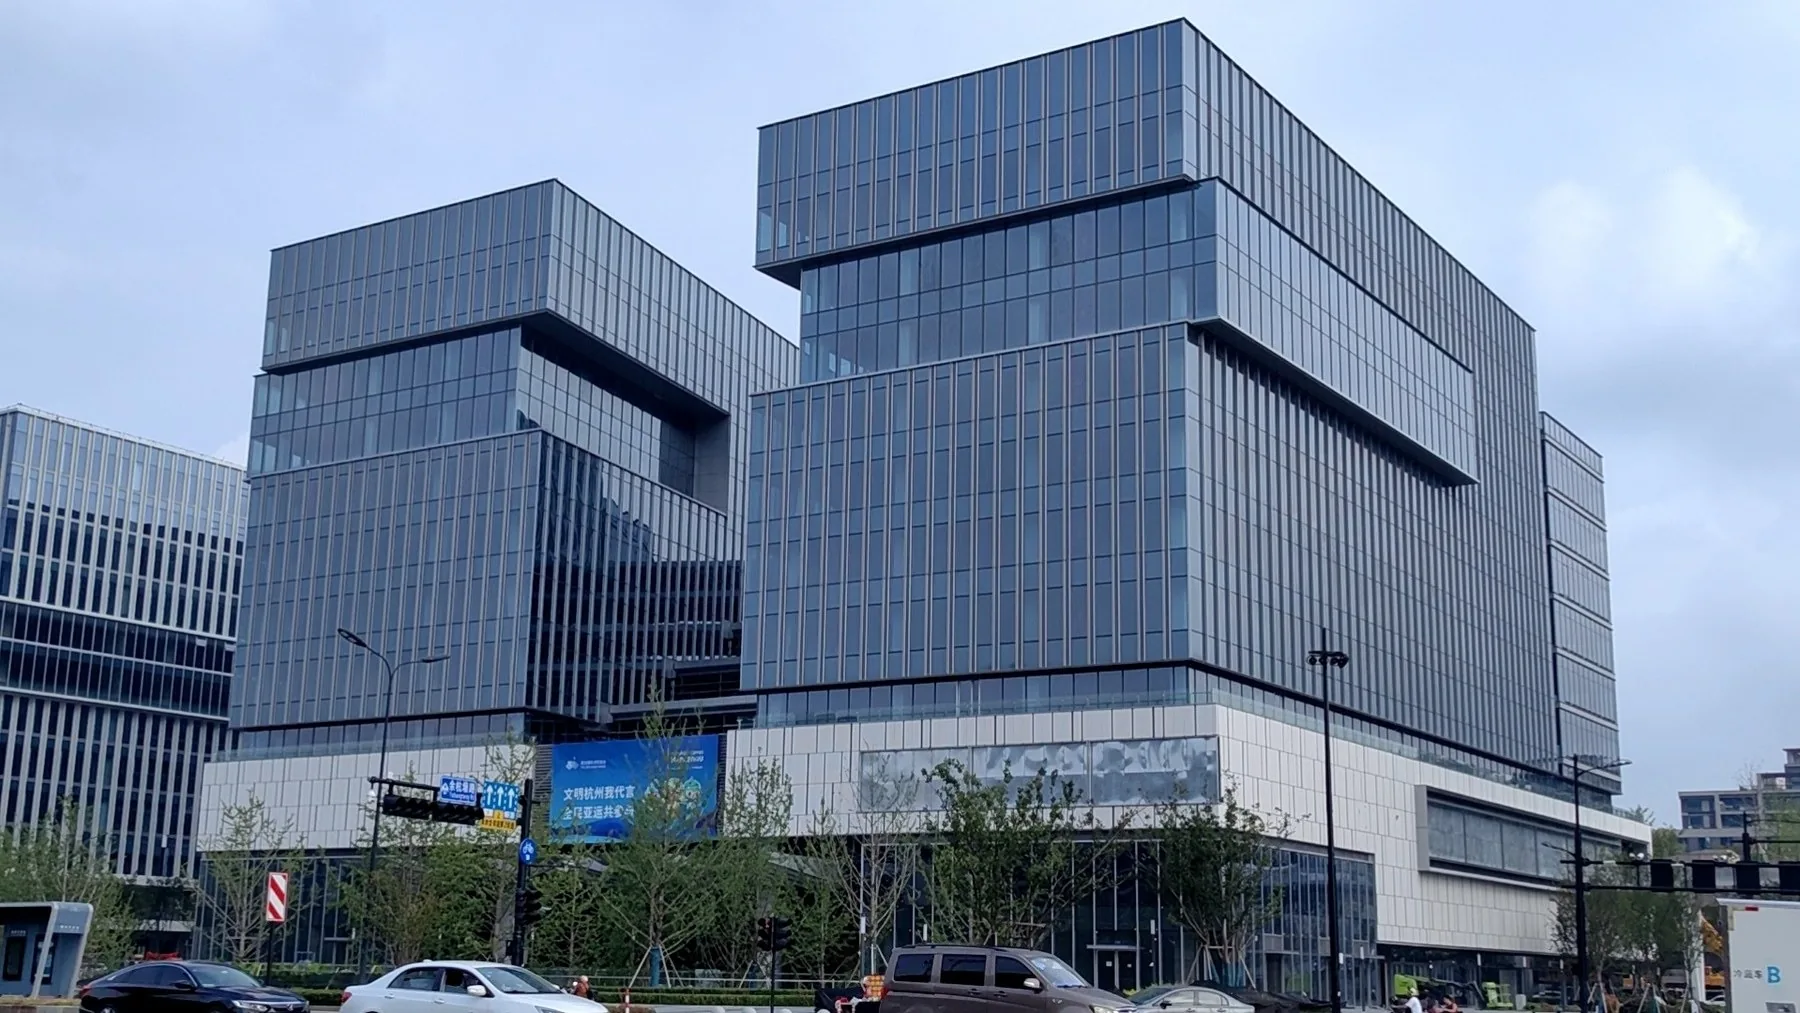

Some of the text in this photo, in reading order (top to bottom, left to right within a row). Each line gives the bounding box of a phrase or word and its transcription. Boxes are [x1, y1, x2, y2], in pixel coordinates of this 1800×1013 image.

[563, 785, 636, 801] 文明杭州我代言
[1767, 966, 1781, 984] B
